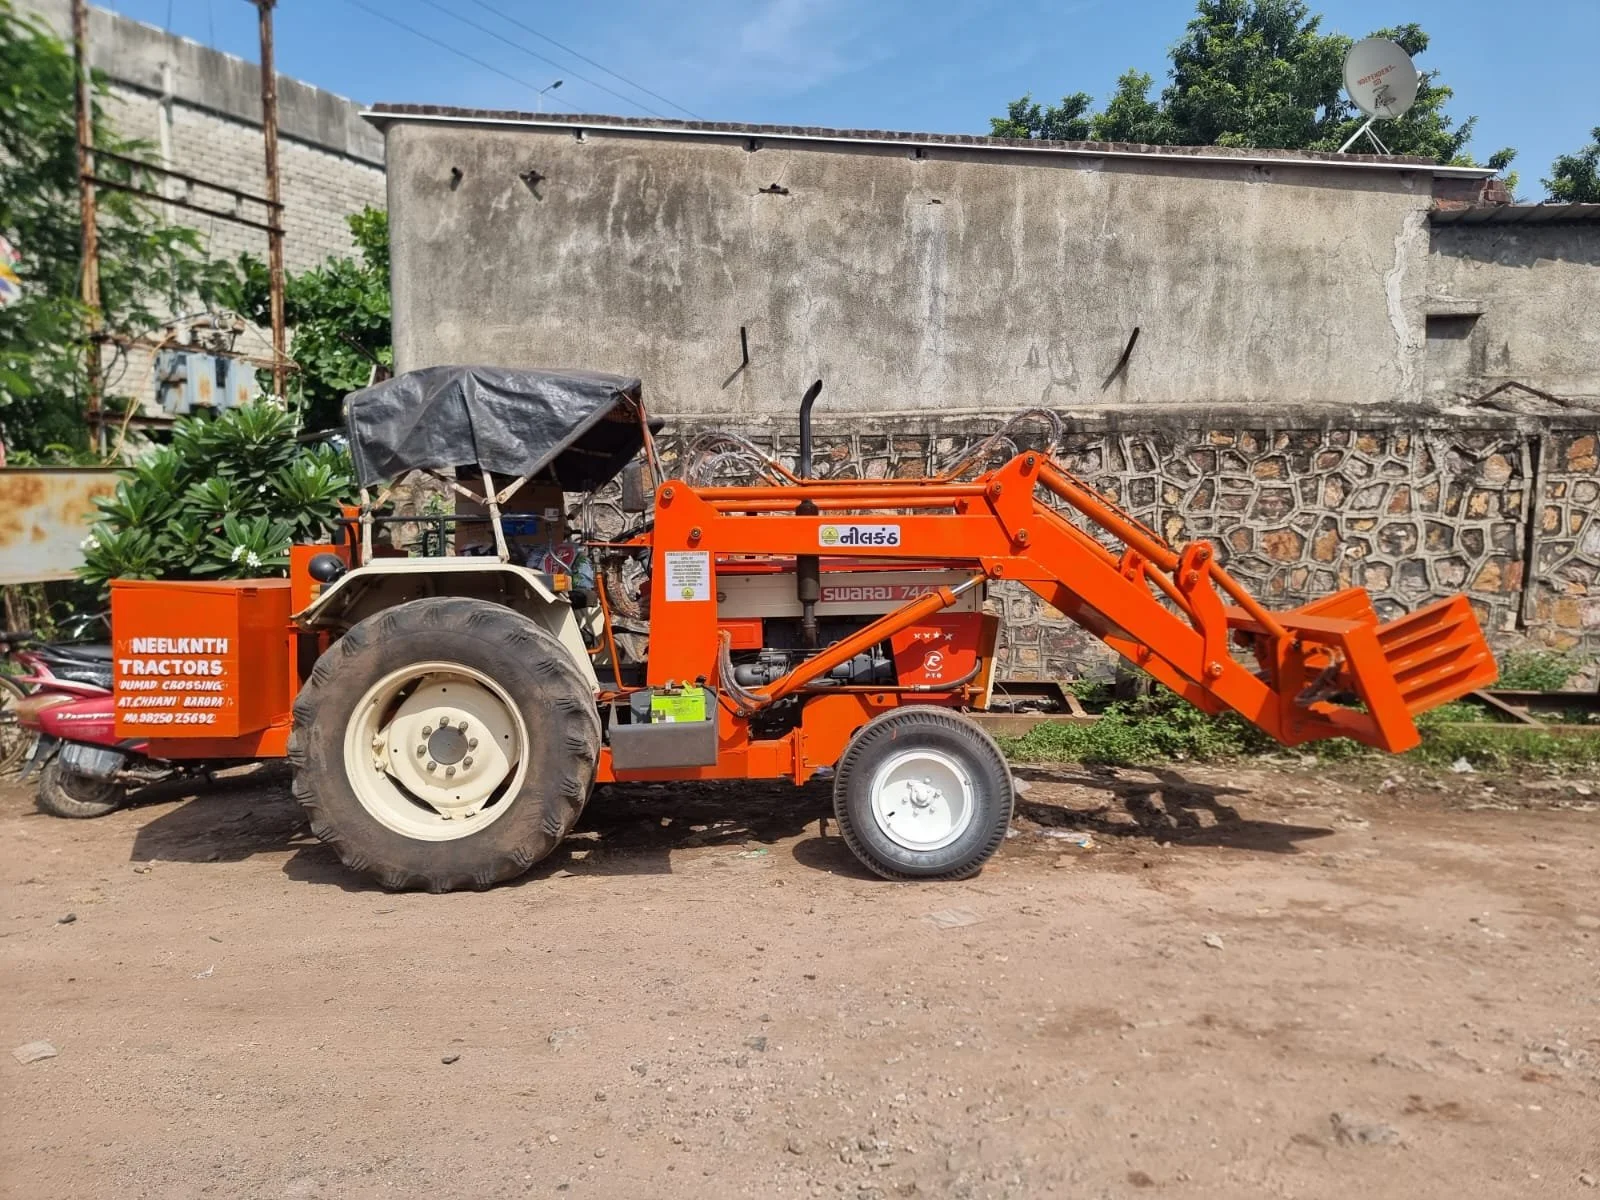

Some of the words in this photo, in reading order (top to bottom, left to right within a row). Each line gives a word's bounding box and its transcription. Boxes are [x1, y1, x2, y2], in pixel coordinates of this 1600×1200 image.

[840, 526, 898, 545] નીલકંઠ
[131, 637, 228, 654] NEELKNTH
[162, 680, 224, 691] CROSSING
